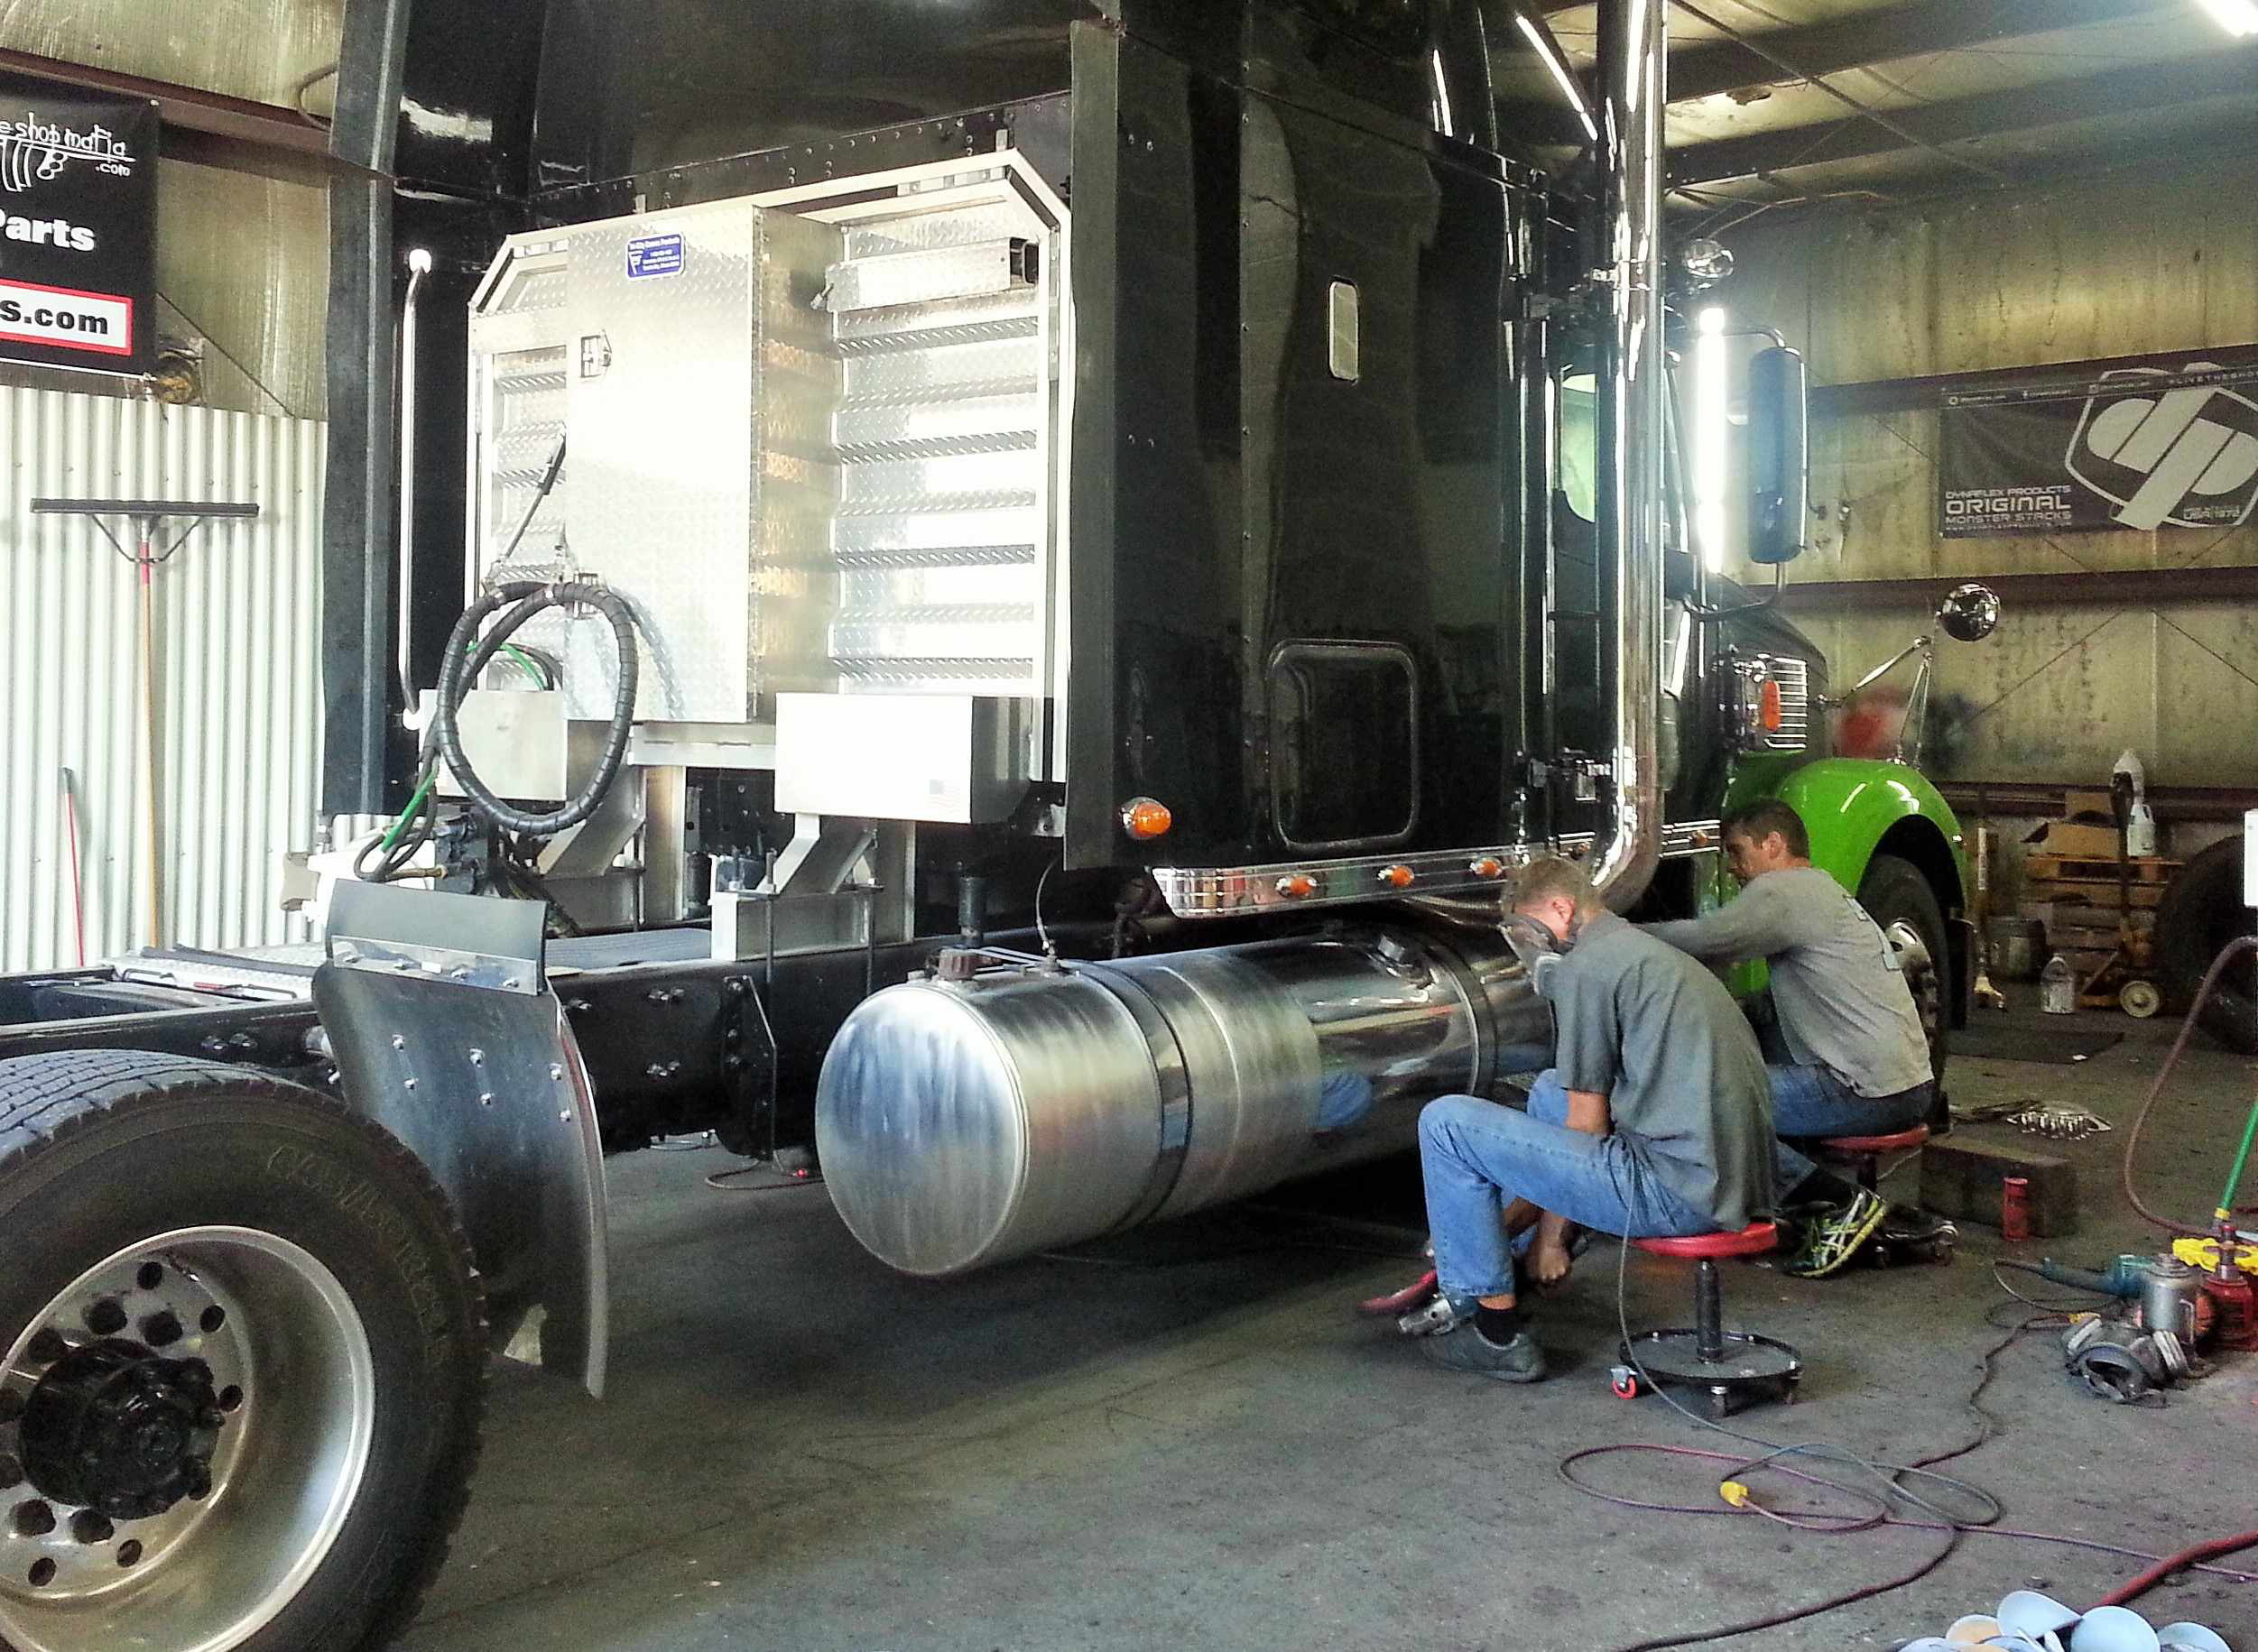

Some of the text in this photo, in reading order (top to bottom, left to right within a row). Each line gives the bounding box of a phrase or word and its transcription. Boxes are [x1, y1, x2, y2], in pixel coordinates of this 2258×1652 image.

[2007, 485, 2071, 496] PRODUCTS
[1946, 494, 2071, 514] ORIGINAL
[1945, 510, 2072, 524] MONSTER STACKS
